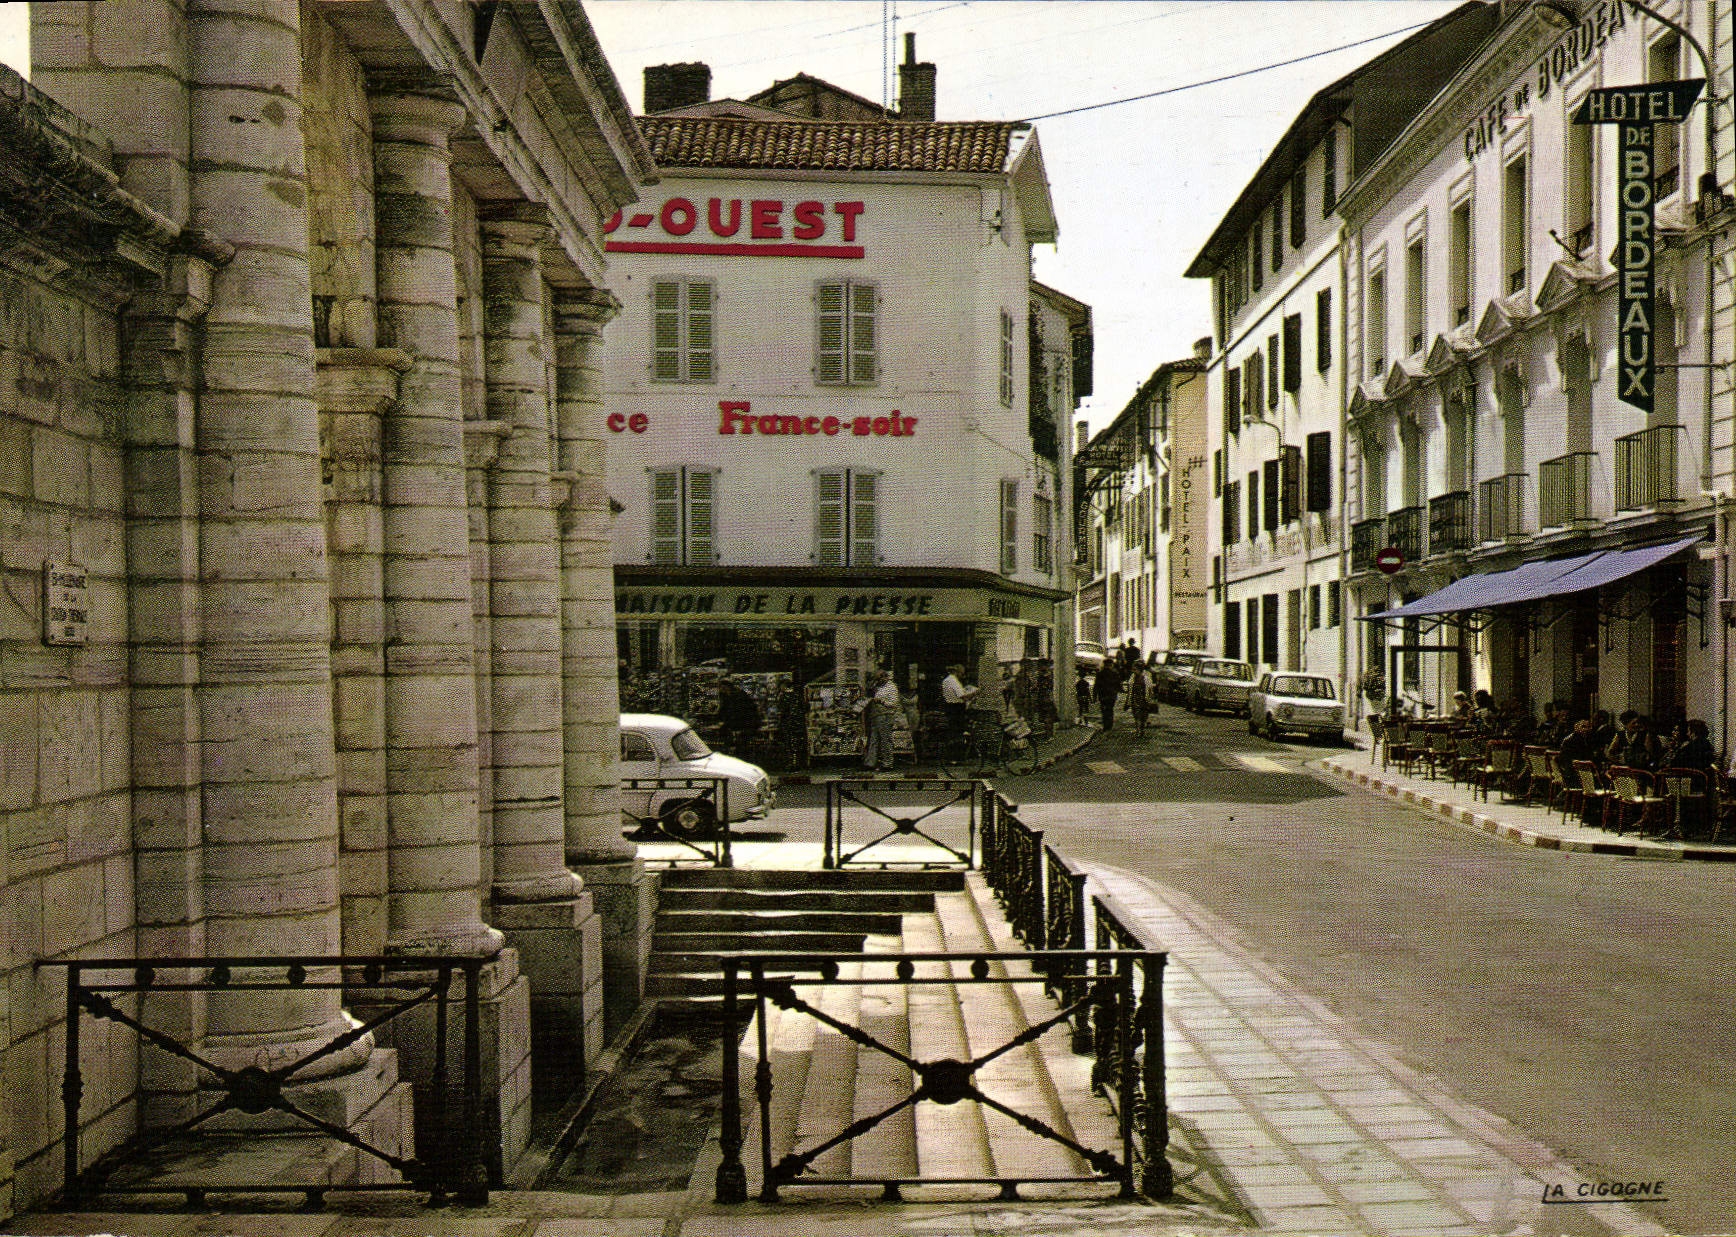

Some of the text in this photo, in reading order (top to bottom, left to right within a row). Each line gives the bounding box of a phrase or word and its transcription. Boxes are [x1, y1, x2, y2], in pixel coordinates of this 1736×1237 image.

[1463, 96, 1507, 162] CAFE
[1536, 0, 1648, 99] BORDEA
[1588, 90, 1683, 121] HOTEL
[1626, 127, 1651, 146] DE
[1623, 150, 1651, 397] BORDEAUX
[719, 400, 918, 436] France-soir
[1181, 468, 1192, 580] HOTEL PAIX
[734, 594, 769, 614] DE
[786, 594, 815, 614] LA
[835, 595, 933, 616] PRESSE
